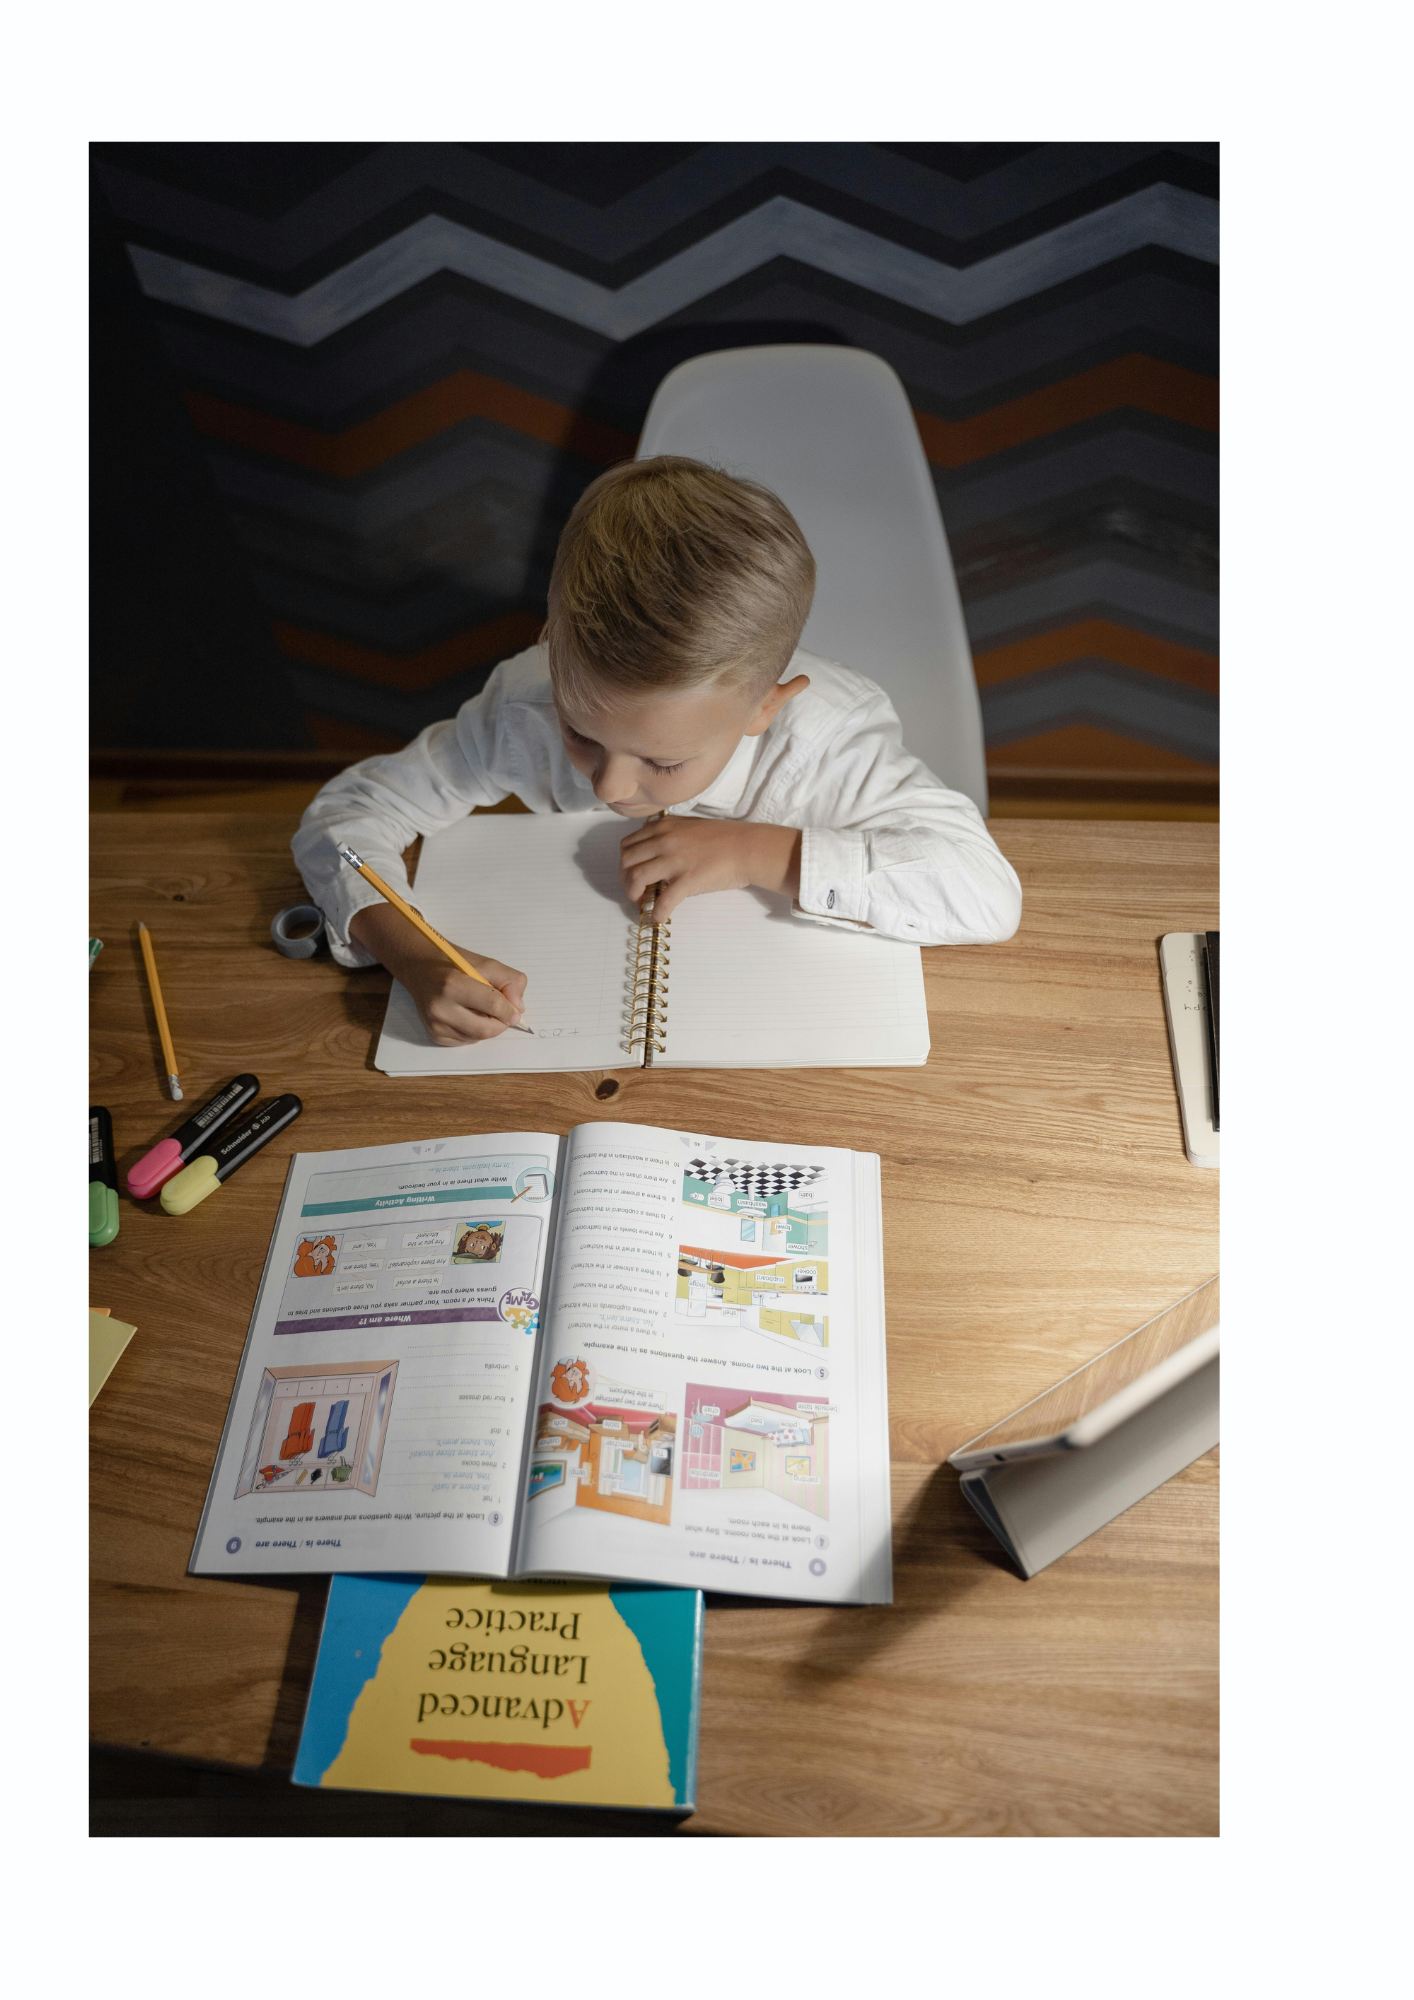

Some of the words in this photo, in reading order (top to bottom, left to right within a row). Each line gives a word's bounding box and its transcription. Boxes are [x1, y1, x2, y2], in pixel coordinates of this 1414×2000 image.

[221, 1129, 252, 1155] Schneider
[260, 1115, 271, 1124] Job
[374, 1198, 405, 1208] Activity
[406, 1196, 435, 1205] Writing
[612, 1206, 639, 1215] cupboard
[638, 1229, 654, 1237] there
[621, 1246, 635, 1254] shelf
[642, 1248, 656, 1256] there
[441, 1287, 453, 1295] you
[615, 1283, 632, 1292] fridge
[639, 1287, 654, 1295] there
[400, 1300, 423, 1308] partner
[505, 1290, 539, 1310] GAME
[322, 1304, 351, 1314] questions
[385, 1314, 411, 1322] Where
[582, 1341, 614, 1349] example.
[650, 1349, 684, 1361] questions
[686, 1355, 698, 1364] the
[700, 1357, 727, 1367] Answer
[729, 1360, 754, 1369] rooms.
[756, 1363, 769, 1371] two
[793, 1367, 812, 1375] Look
[819, 1368, 825, 1378] 5
[315, 1515, 342, 1523] answers
[344, 1514, 357, 1522] and
[358, 1511, 393, 1522] questions
[415, 1511, 441, 1520] picture.
[443, 1512, 454, 1520] the
[466, 1512, 485, 1520] Look
[493, 1514, 499, 1523] 6
[255, 1516, 283, 1524] example.
[752, 1520, 770, 1528] each
[706, 1526, 720, 1535] Say
[782, 1523, 788, 1531] is
[791, 1524, 811, 1532] there
[752, 1532, 765, 1540] two
[767, 1534, 779, 1542] the
[792, 1536, 810, 1544] Look
[230, 1541, 238, 1550] 9
[272, 1540, 297, 1549] There
[306, 1540, 314, 1548] is
[317, 1539, 342, 1548] There
[689, 1550, 706, 1558] are
[710, 1553, 739, 1564] There
[749, 1558, 758, 1566] is
[762, 1558, 792, 1569] There
[445, 1608, 582, 1640] Practice
[428, 1643, 590, 1685] Language
[416, 1692, 591, 1729] Advanced
